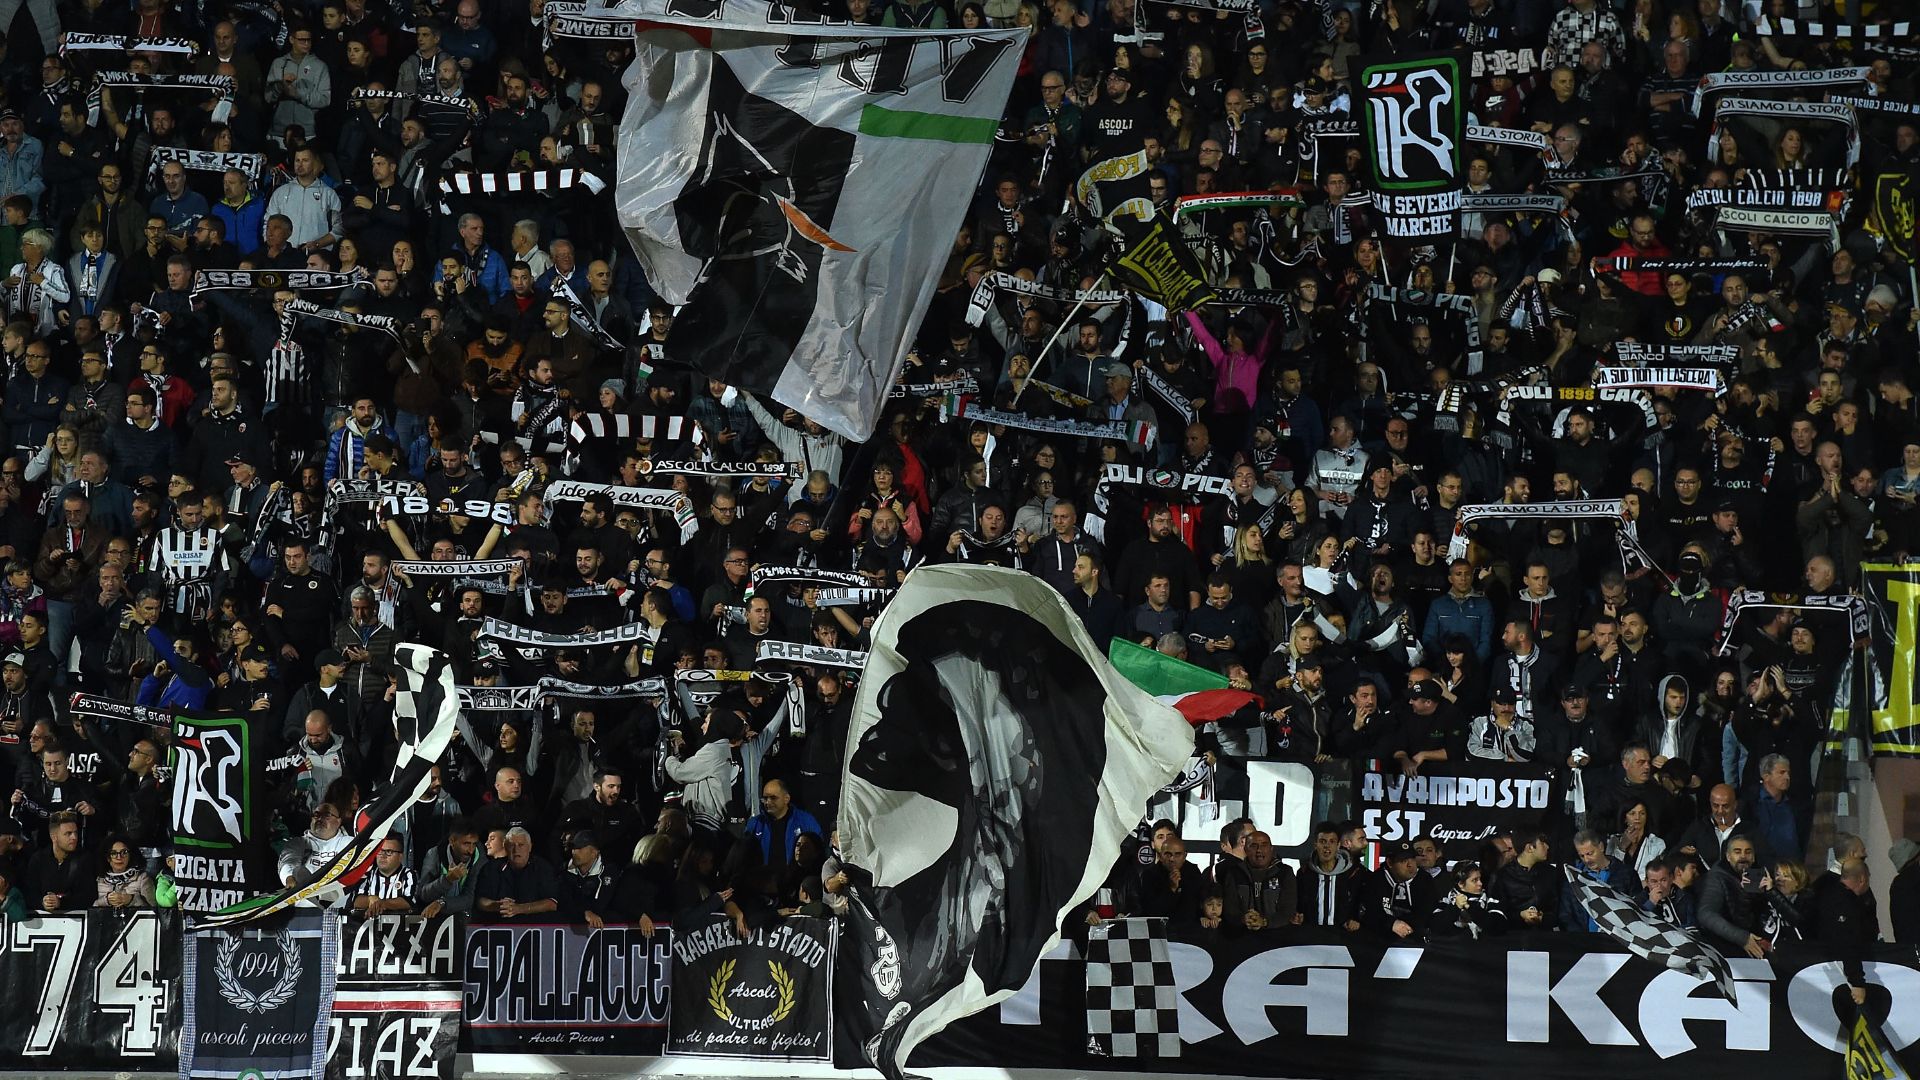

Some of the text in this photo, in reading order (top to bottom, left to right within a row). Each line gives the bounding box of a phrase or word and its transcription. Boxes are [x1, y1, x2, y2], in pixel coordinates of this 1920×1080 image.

[1724, 69, 1857, 83] ASCOLI CALCIO 1898
[1739, 101, 1784, 112] SIAMO
[1787, 103, 1805, 113] LA
[1099, 119, 1133, 130] ASCOLI
[1482, 130, 1496, 139] LA
[1500, 131, 1544, 144] STORIA
[1472, 197, 1521, 206] CALCIO
[1525, 197, 1555, 206] 1898
[1688, 189, 1822, 209] ASCOLI CALCIO 1898
[1385, 214, 1453, 238] MARCHE
[1764, 213, 1810, 225] CALCIO
[1815, 215, 1831, 226] 189
[1618, 352, 1665, 362] BIANCO
[1610, 369, 1629, 384] SUD
[1558, 389, 1595, 401] 1898
[656, 460, 785, 472] ASCOLI CALCIO 1898
[1488, 504, 1539, 513] SIAMO
[1542, 504, 1561, 514] LA
[1562, 503, 1615, 514] STORIA
[407, 561, 513, 574] SIAMO LA STOR
[1361, 771, 1551, 809] AVAMPOSTO
[1362, 808, 1426, 842] EST
[1429, 823, 1474, 844] Cupra
[174, 854, 246, 884] RIGATA
[336, 914, 456, 975] IAZZA
[768, 924, 826, 970] STADIO
[238, 951, 281, 979] 1994
[465, 927, 672, 1024] SPALLACCE
[728, 981, 777, 1000] Ascoli
[727, 1013, 775, 1032] ULTRAS
[200, 1024, 308, 1056] ascoli piceno
[529, 1032, 605, 1045] Ascoli Piceno
[704, 1031, 749, 1048] padre
[754, 1032, 768, 1046] in
[770, 1031, 823, 1052] figlio!
